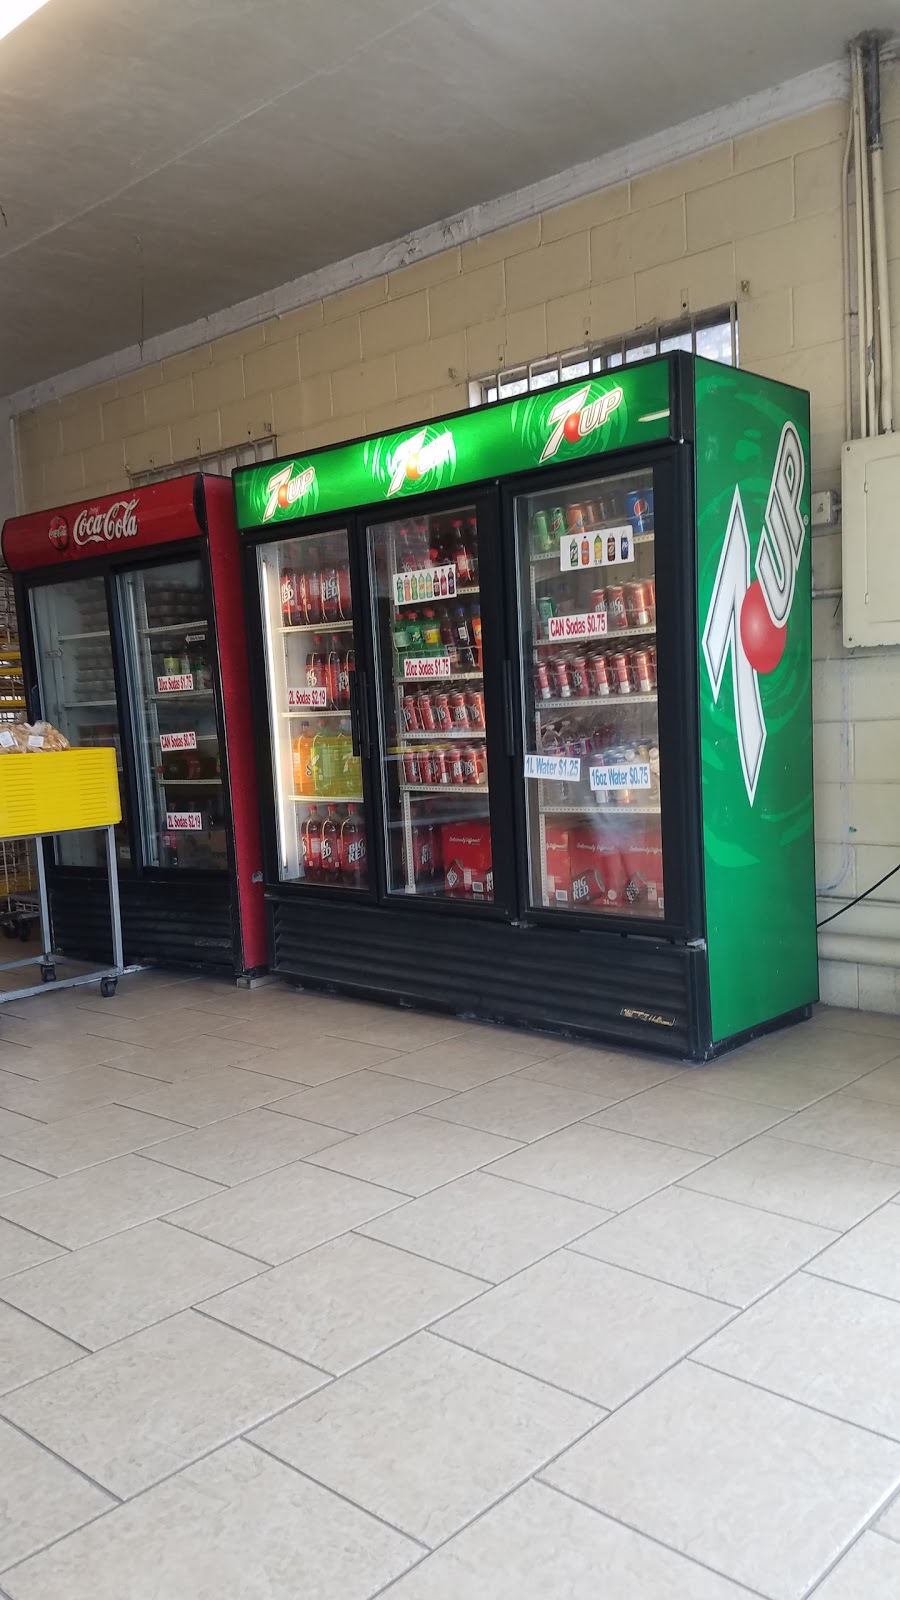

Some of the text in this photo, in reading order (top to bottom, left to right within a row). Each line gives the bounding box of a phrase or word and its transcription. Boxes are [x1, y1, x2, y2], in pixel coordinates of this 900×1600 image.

[550, 613, 606, 638] CAN Sodas $0.75
[405, 657, 450, 676] 20oz Sodas $1.75
[168, 676, 181, 690] Sodas
[289, 689, 326, 706] 2L Sodas $2.19
[161, 735, 171, 749] CAN
[171, 734, 184, 748] Sodas
[525, 756, 579, 778] 1L Water $1.25
[591, 765, 650, 787] 16oz Water $0.75
[168, 815, 174, 829] 2L
[174, 815, 188, 828] Sodas
[573, 876, 586, 891] BIG
[573, 886, 589, 901] RED
